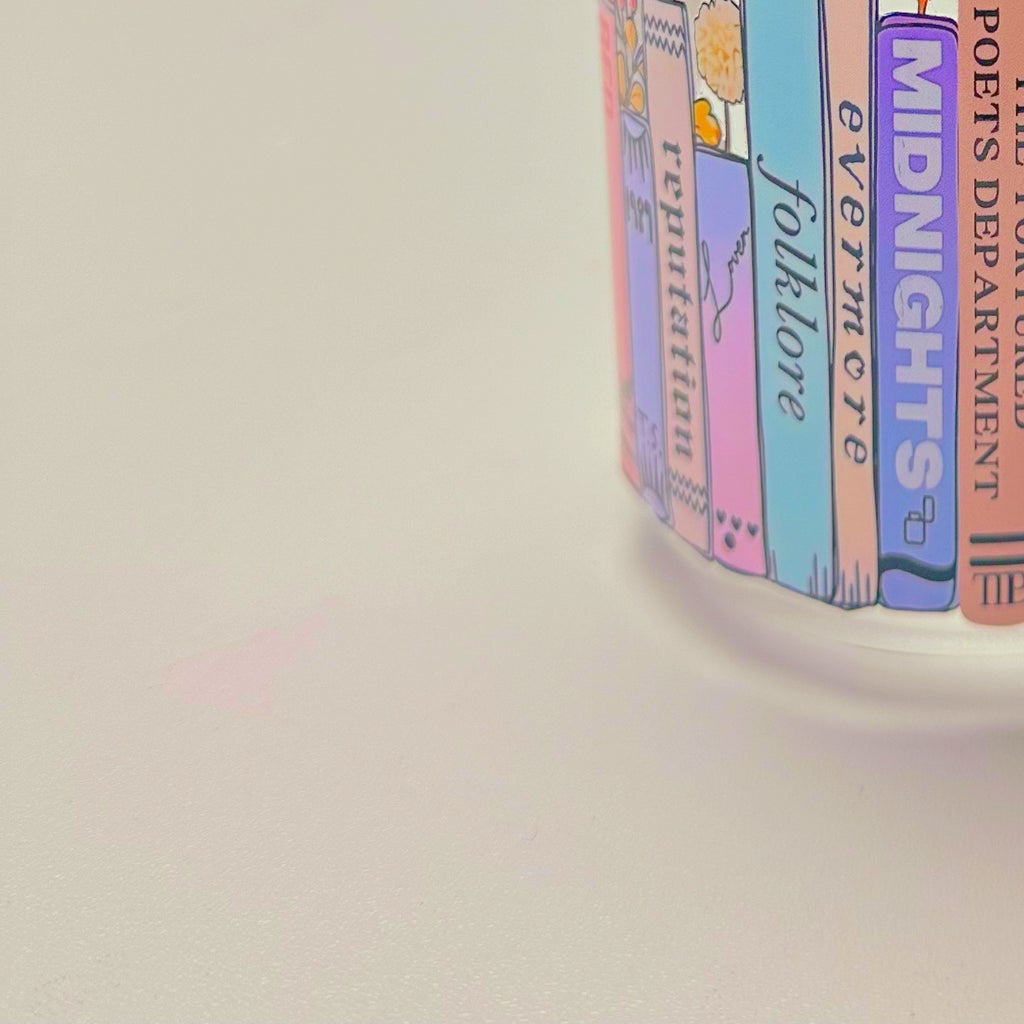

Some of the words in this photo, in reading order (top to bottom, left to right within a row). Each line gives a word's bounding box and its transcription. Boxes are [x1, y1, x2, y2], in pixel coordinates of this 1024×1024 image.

[973, 6, 1001, 166] POETS
[660, 140, 696, 460] reputation
[701, 226, 750, 343] Lover
[758, 154, 818, 422] folklore
[838, 98, 868, 465] evermore
[892, 39, 943, 490] MIDNIGHTS
[973, 179, 1000, 500] DEPARTMENT
